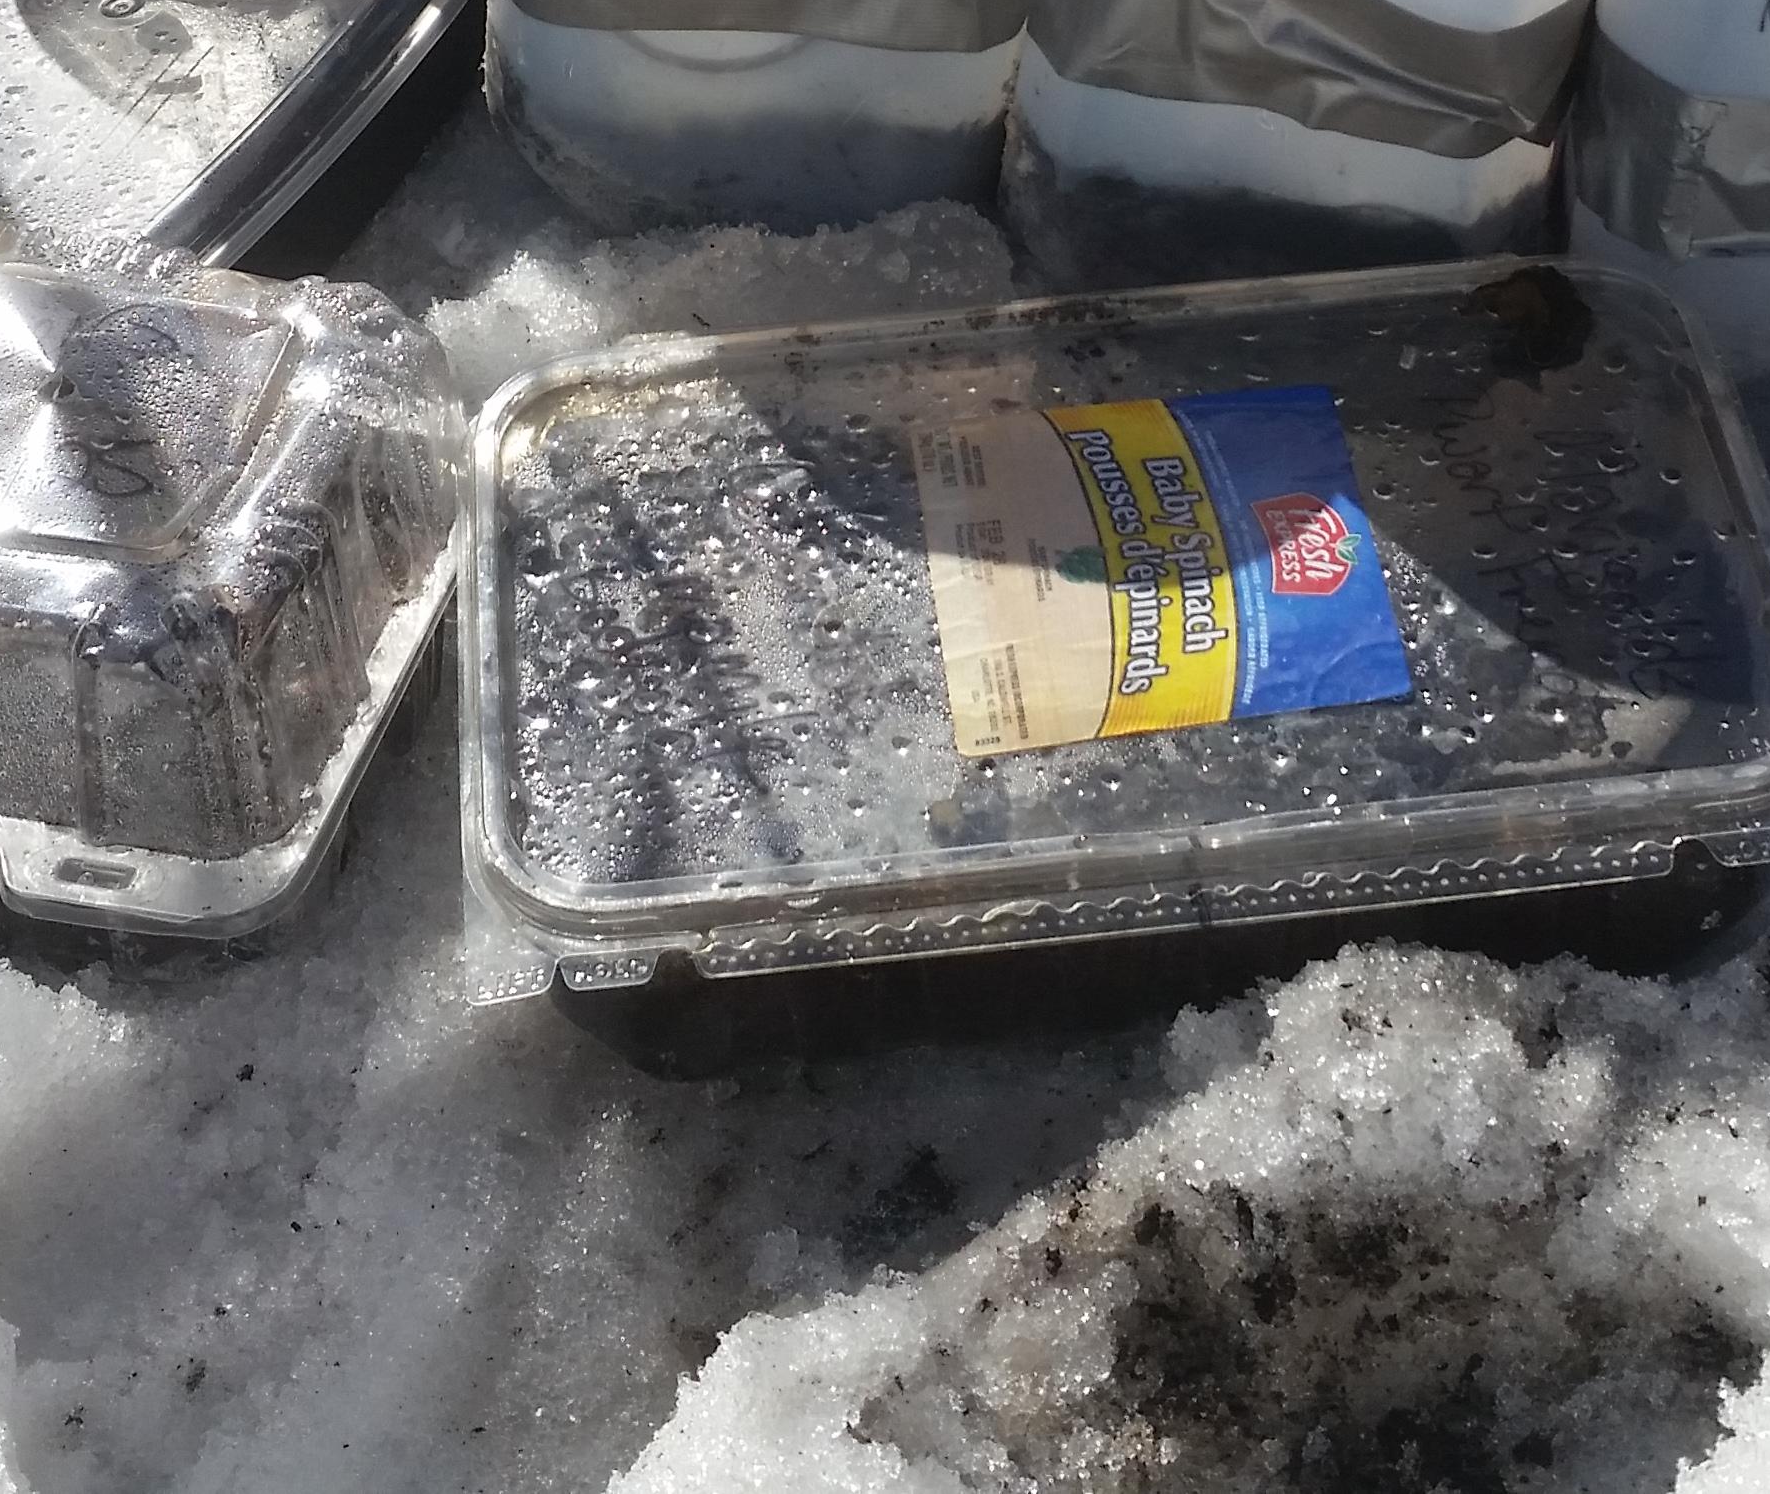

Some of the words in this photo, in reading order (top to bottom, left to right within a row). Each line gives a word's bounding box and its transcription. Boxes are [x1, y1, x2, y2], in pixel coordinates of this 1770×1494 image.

[1143, 456, 1204, 530] Baby
[1067, 428, 1137, 536] Pousses
[1115, 538, 1169, 695] d'épinards
[1265, 509, 1302, 584] EXPRESS
[1293, 506, 1335, 581] Fresh
[1167, 531, 1228, 654] Spinach
